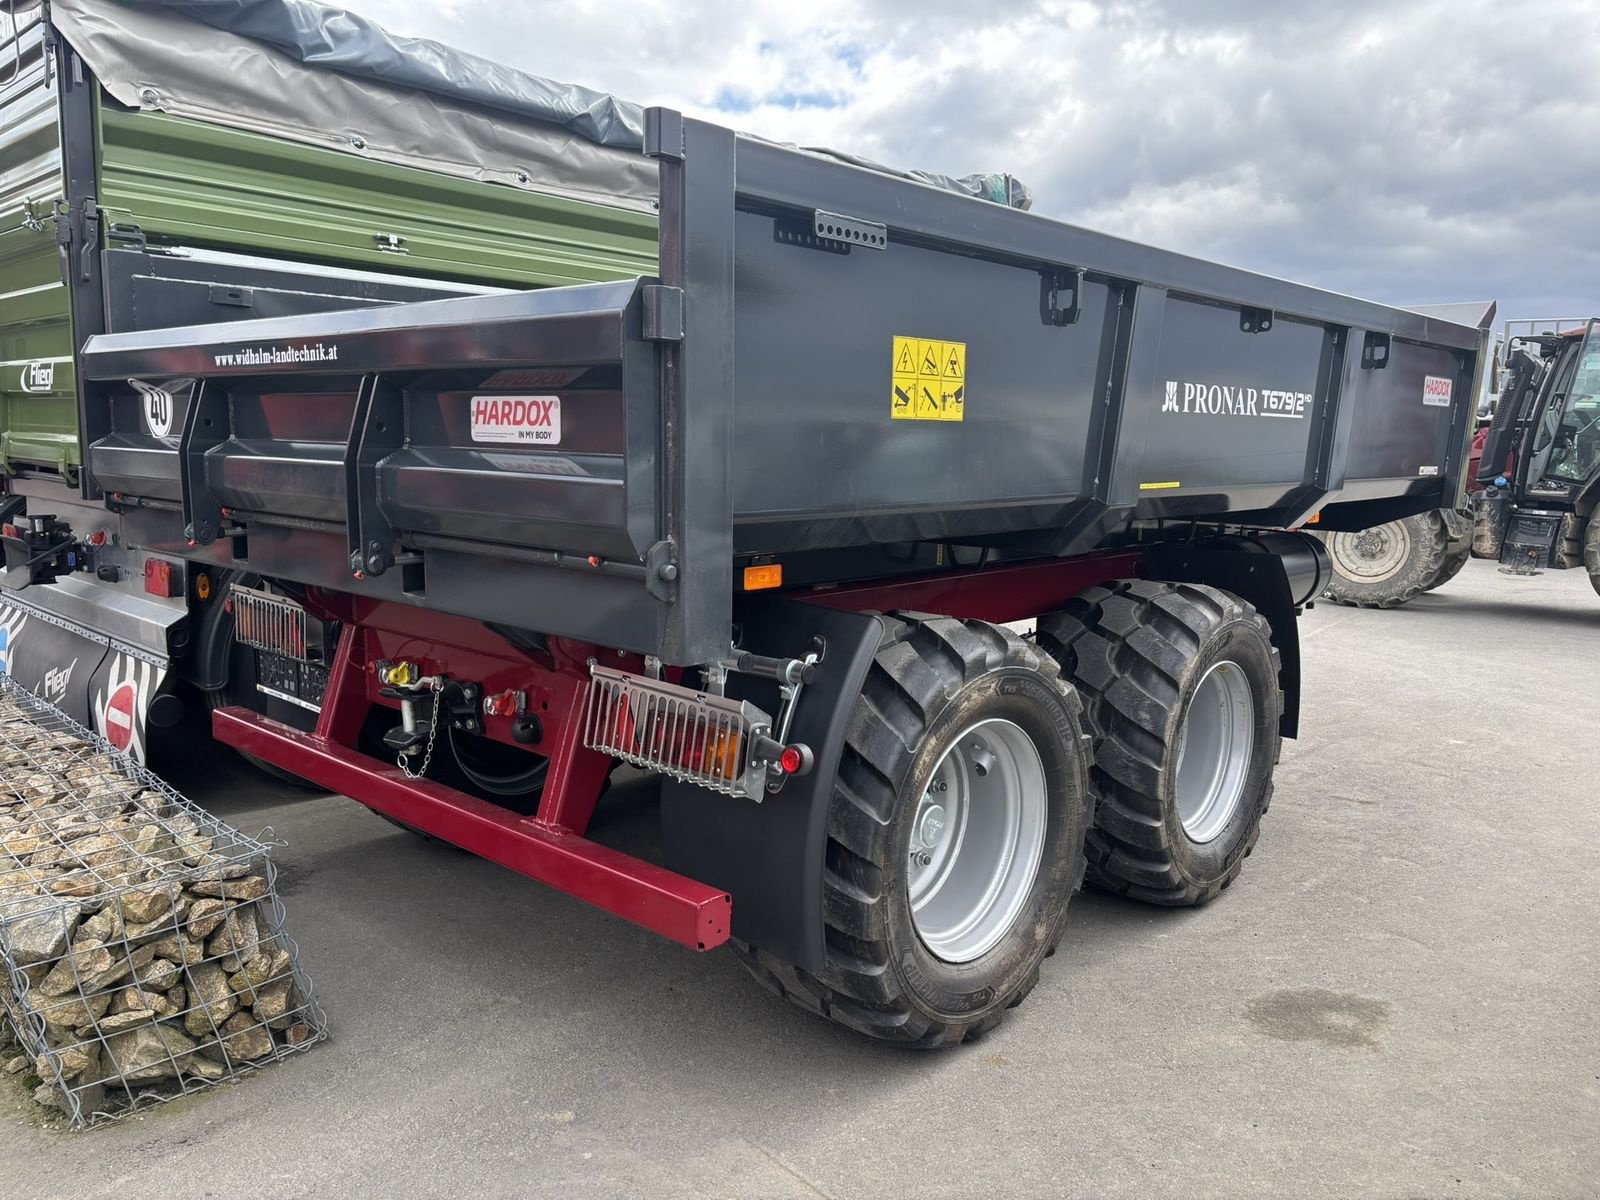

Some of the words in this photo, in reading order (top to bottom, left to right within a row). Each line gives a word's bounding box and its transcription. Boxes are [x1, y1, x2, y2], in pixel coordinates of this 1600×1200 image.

[214, 343, 338, 366] www.widhalm-landtechnik.at
[30, 361, 54, 390] Fliegl
[144, 388, 168, 426] 40
[1182, 383, 1258, 416] PRONAR
[518, 430, 525, 439] IN
[525, 431, 535, 439] MY
[535, 431, 553, 440] BODY
[45, 657, 78, 699] Fliegl
